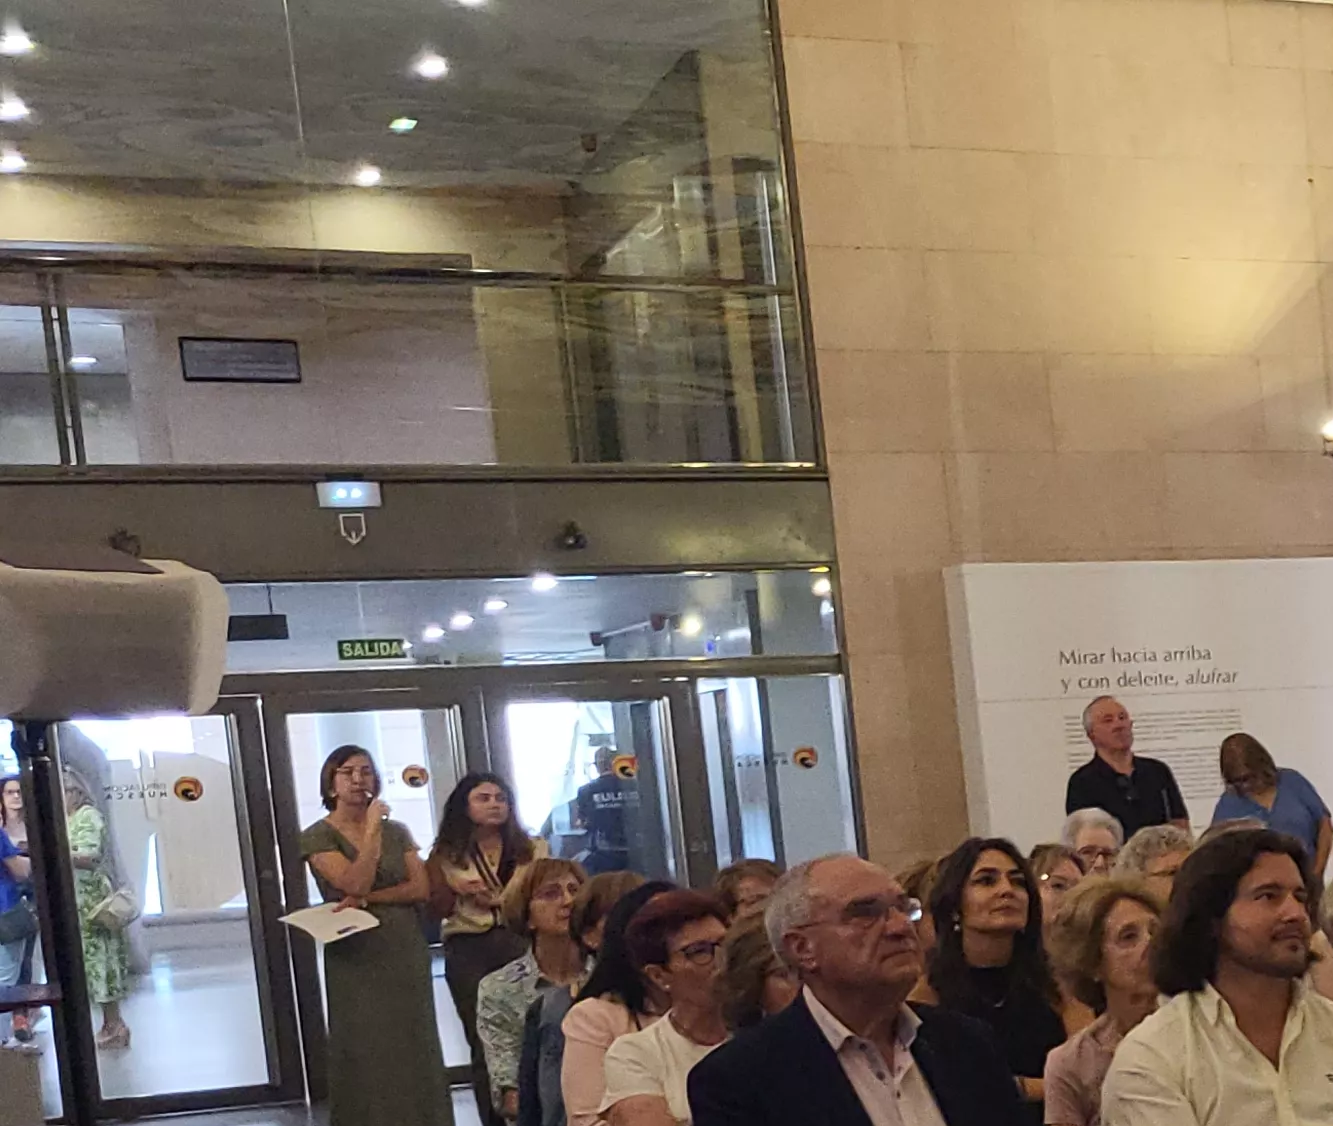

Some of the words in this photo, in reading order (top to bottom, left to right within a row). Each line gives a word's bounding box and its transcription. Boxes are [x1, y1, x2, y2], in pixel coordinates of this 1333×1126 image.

[342, 641, 403, 657] SALIDA
[1058, 649, 1106, 666] Mirar
[1111, 645, 1158, 664] hacia
[1163, 644, 1213, 662] arriba
[1060, 677, 1072, 693] y
[1078, 675, 1110, 690] con
[1116, 670, 1179, 688] deleite,
[1185, 667, 1239, 685] alufrar
